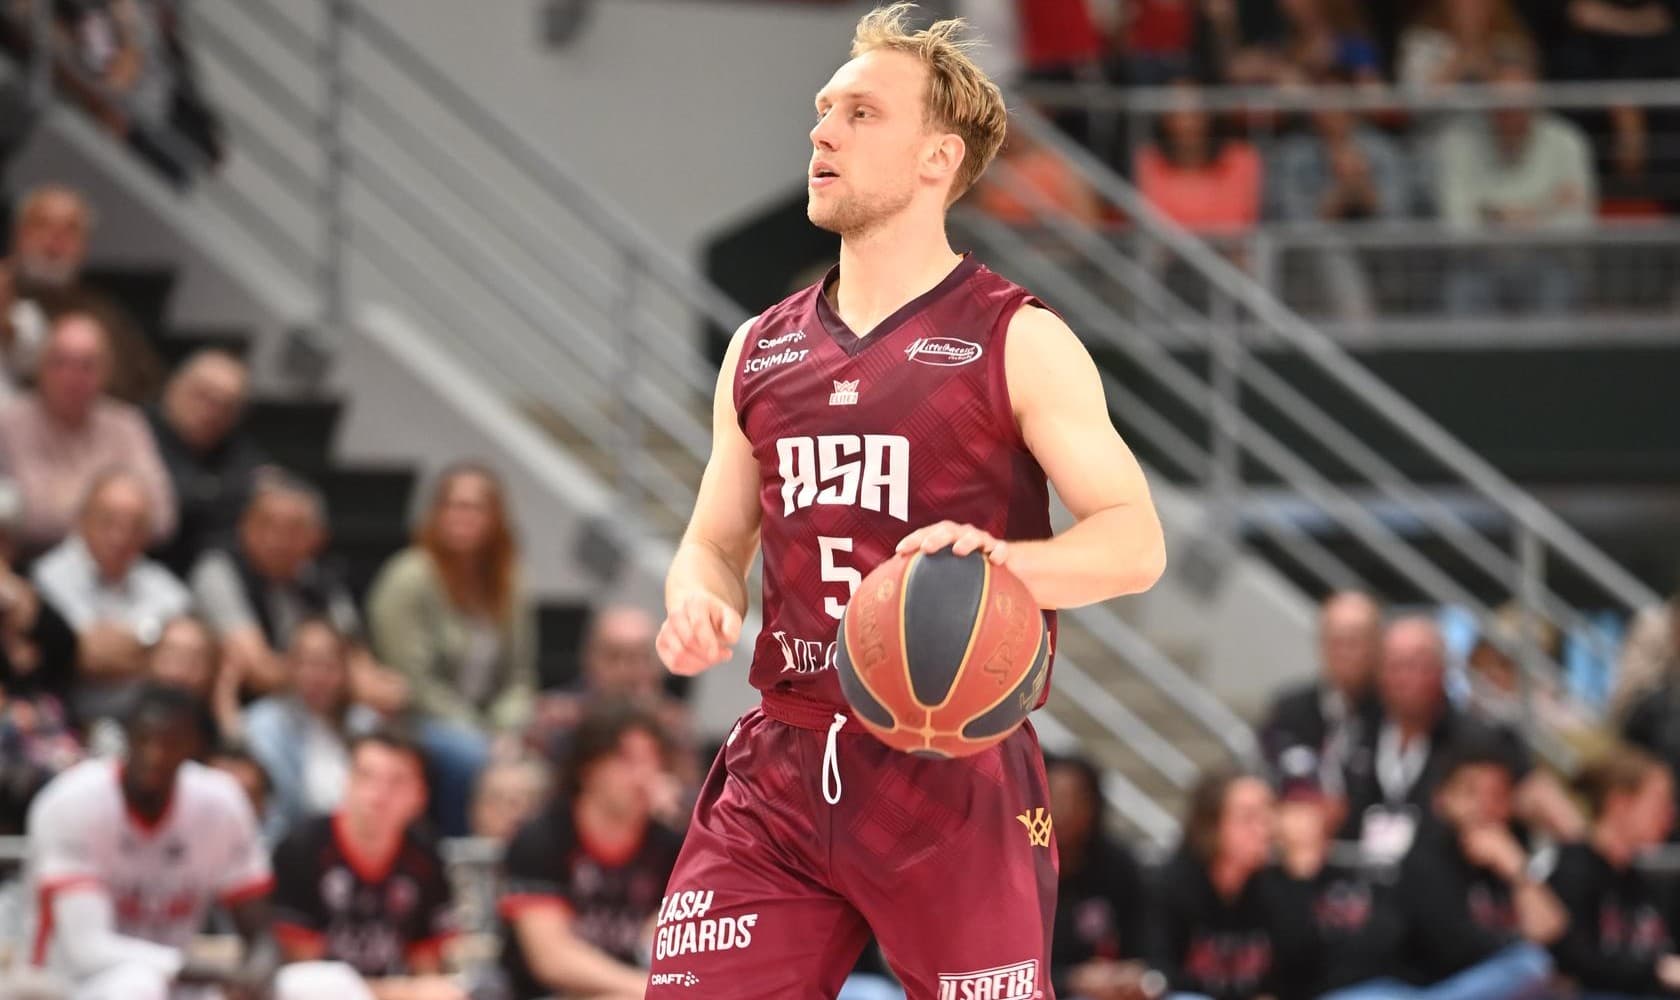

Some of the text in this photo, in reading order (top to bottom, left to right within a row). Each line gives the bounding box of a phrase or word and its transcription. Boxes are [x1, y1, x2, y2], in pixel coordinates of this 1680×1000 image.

[776, 434, 910, 522] ASA
[817, 536, 862, 619] 5
[656, 914, 758, 960] GUARDS
